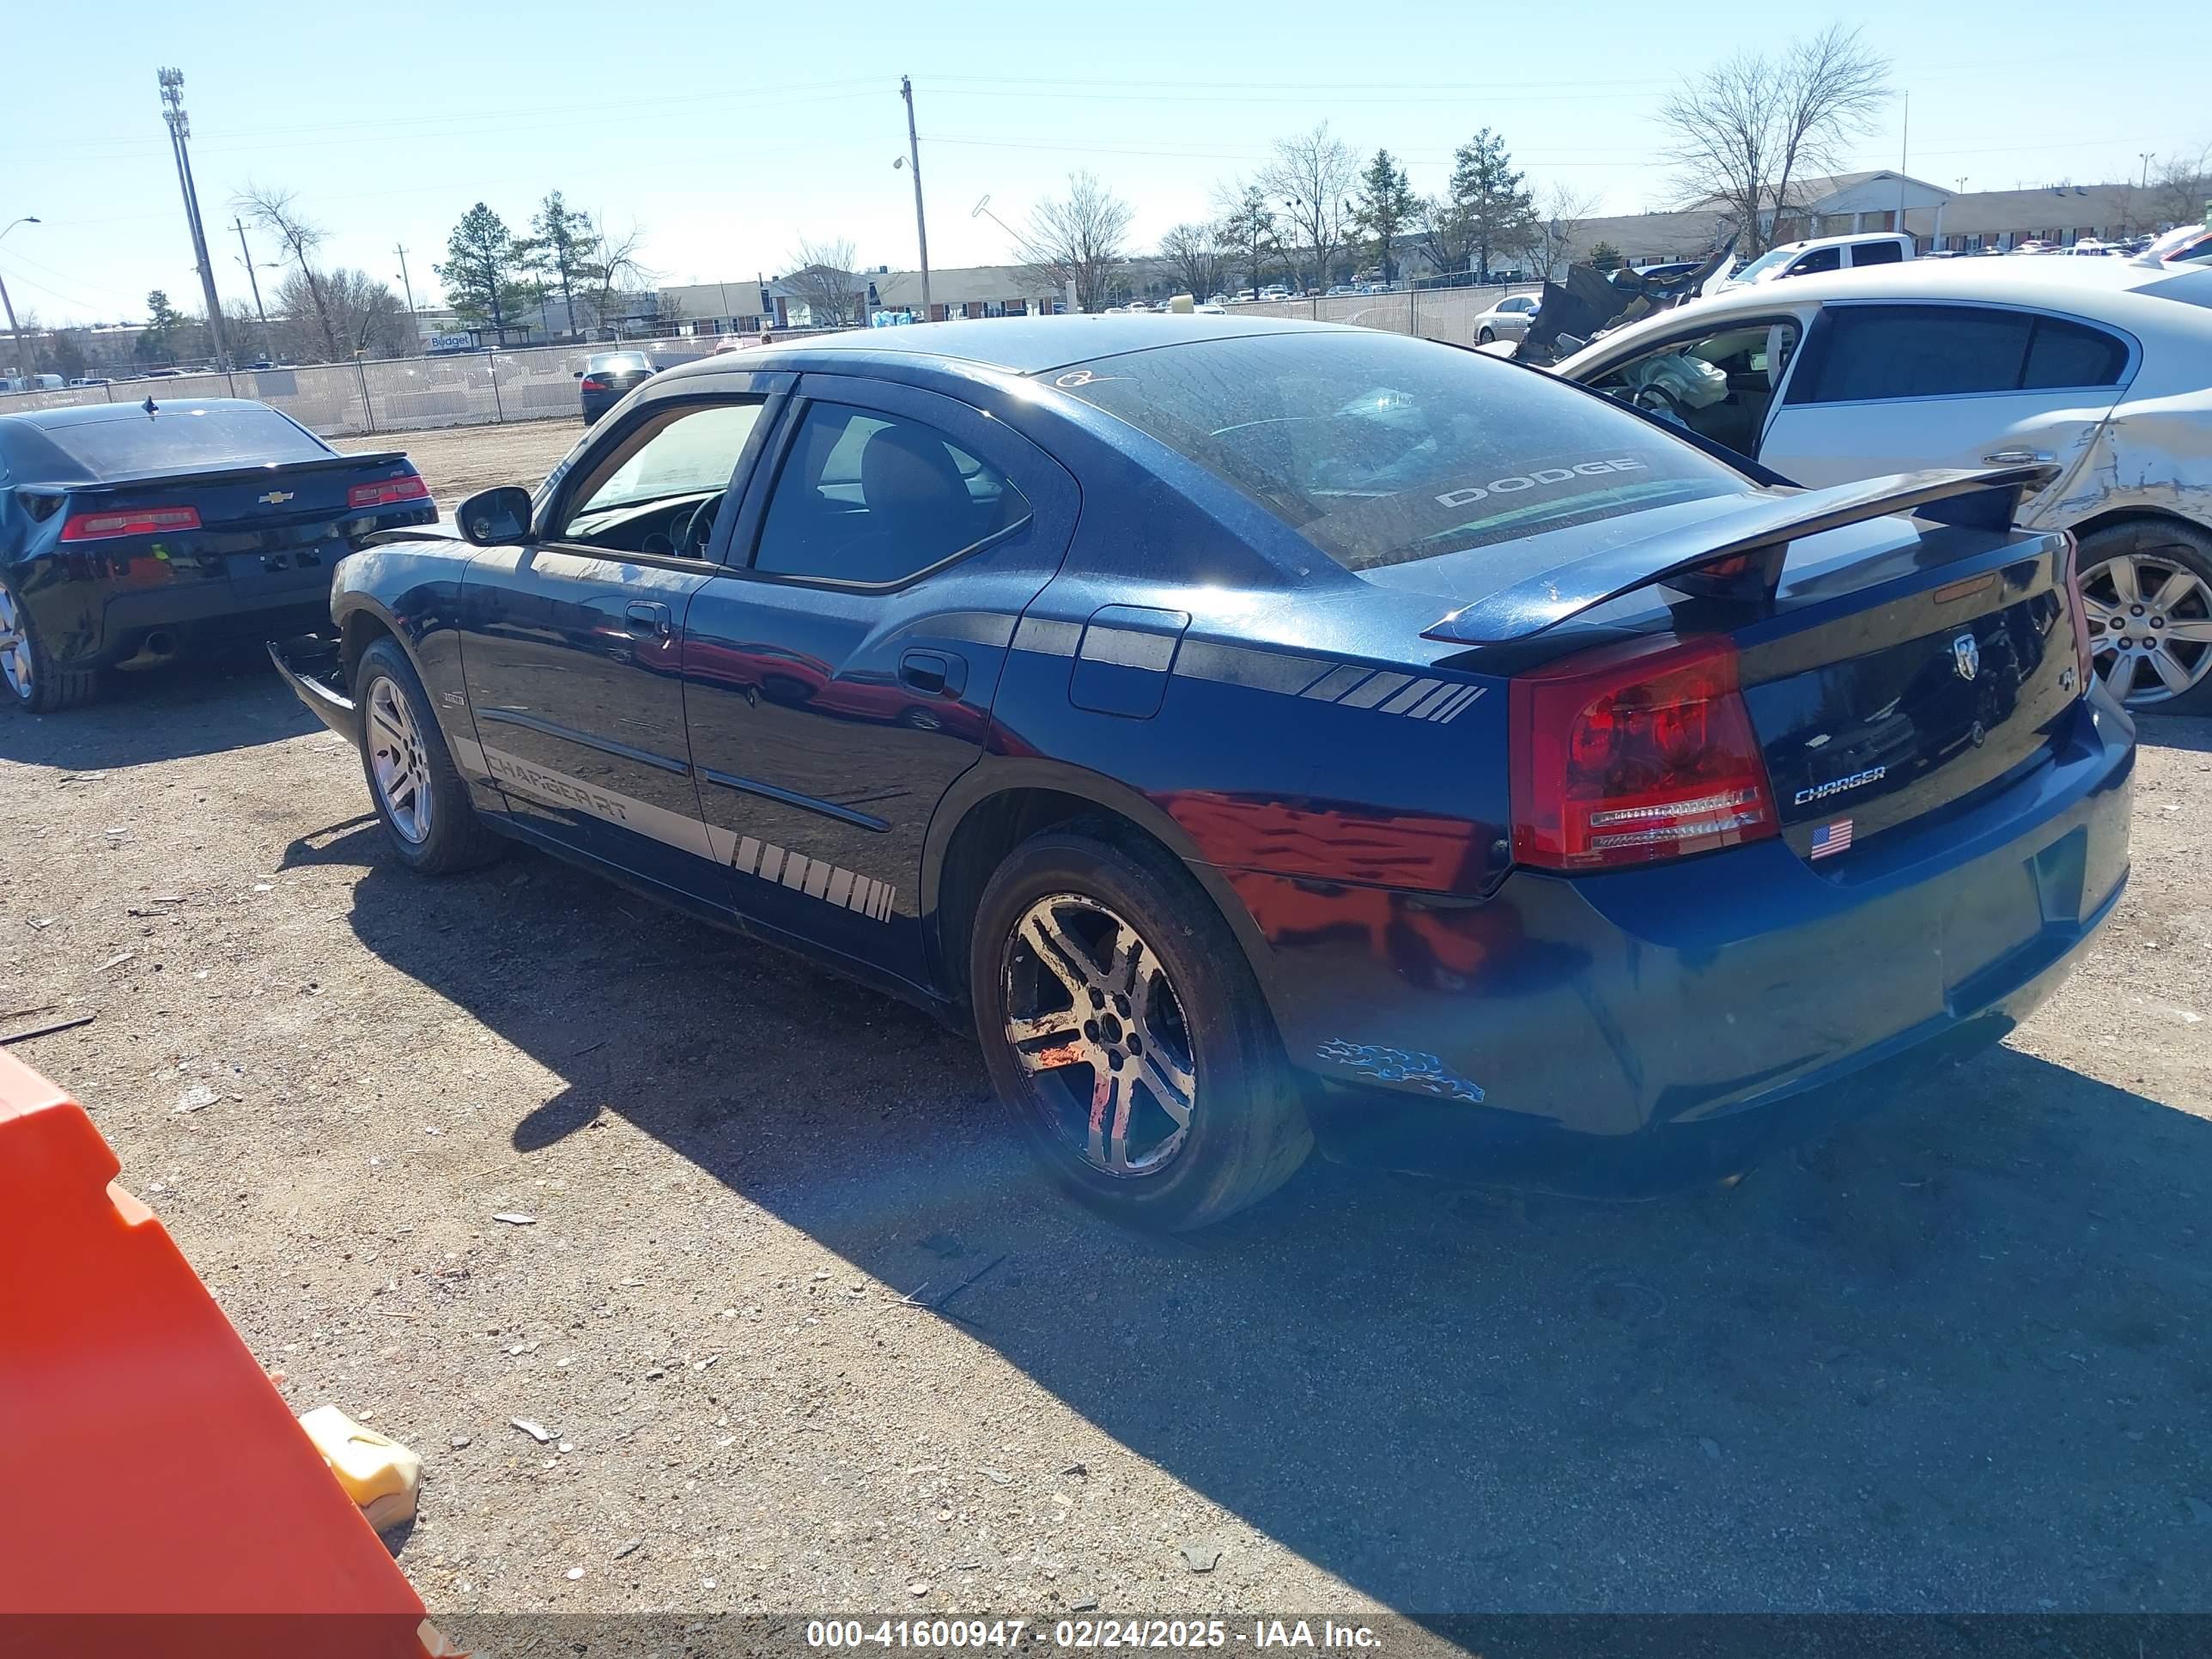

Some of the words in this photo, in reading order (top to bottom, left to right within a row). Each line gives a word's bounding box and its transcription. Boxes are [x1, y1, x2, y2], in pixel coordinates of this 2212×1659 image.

[431, 336, 469, 348] Budget
[1435, 458, 1648, 508] DODGE
[1794, 766, 1887, 805] CHARGER
